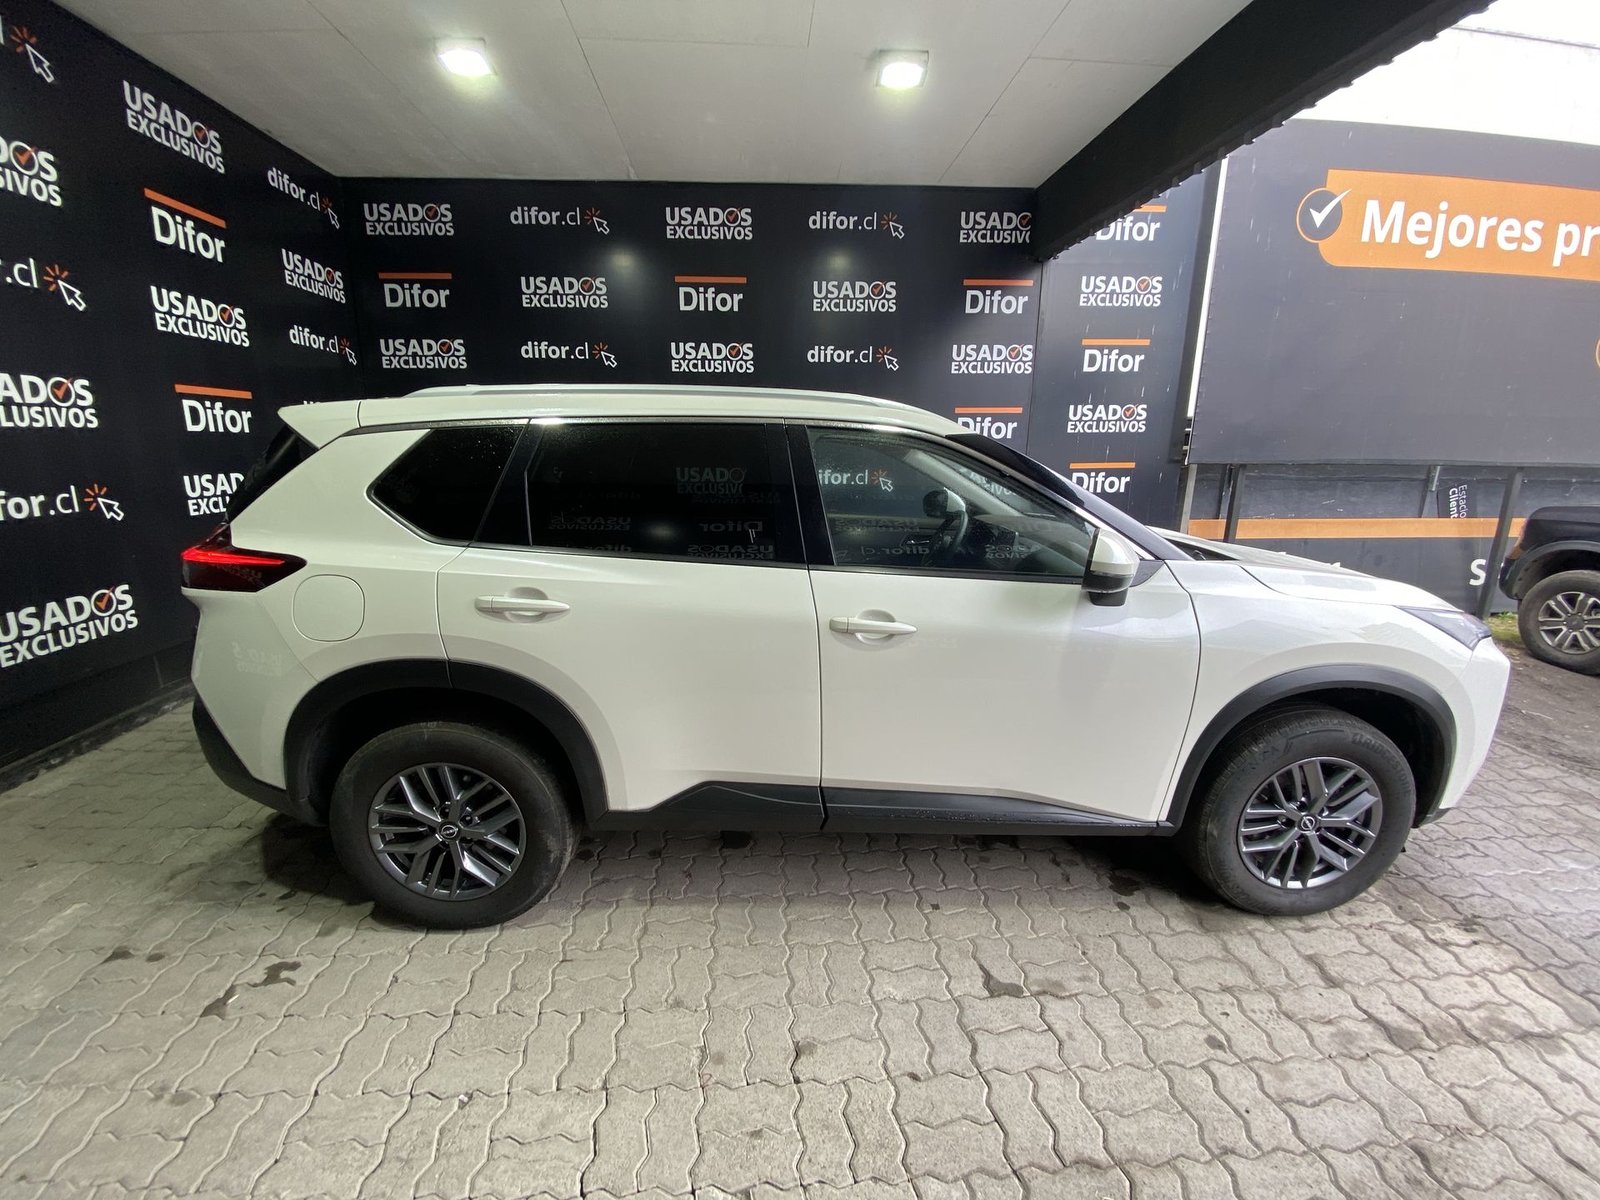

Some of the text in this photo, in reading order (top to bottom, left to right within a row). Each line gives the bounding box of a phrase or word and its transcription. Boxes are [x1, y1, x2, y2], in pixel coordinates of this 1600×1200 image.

[123, 80, 222, 155] USADOS
[127, 109, 225, 175] EXCLUSIVOS
[267, 167, 321, 211] difor.cl
[363, 203, 453, 223] USADOS
[510, 206, 580, 225] difor.cl
[665, 206, 752, 226] USADOS
[808, 211, 877, 230] difor.cl
[151, 206, 225, 263] Difor
[366, 221, 454, 236] EXCLUSIVOS
[666, 225, 753, 240] EXCLUSIVOS
[1361, 200, 1544, 259] Mejores
[281, 248, 344, 289] USADOS
[284, 270, 346, 304] EXCLUSIVOS
[520, 276, 607, 295] USADOS
[813, 281, 896, 299] USADOS
[1081, 276, 1163, 294] USADOS
[384, 283, 450, 309] Difor
[522, 294, 608, 308] EXCLUSIVOS
[679, 286, 743, 312] Difor
[812, 298, 896, 312] EXCLUSIVOS
[965, 289, 1028, 314] Difor
[1079, 293, 1161, 307] EXCLUSIVOS
[150, 285, 247, 330] USADOS
[155, 312, 250, 348] EXCLUSIVOS
[289, 325, 339, 354] difor.cl
[380, 339, 465, 357] USADOS
[521, 341, 589, 360] difor.cl
[671, 342, 754, 361] USADOS
[807, 346, 873, 363] difor.cl
[951, 344, 1033, 362] USADOS
[382, 356, 467, 369] EXCLUSIVOS
[671, 359, 754, 373] EXCLUSIVOS
[951, 361, 1033, 374] EXCLUSIVOS
[1082, 348, 1145, 373] Difor
[182, 399, 252, 433] Difor
[1068, 404, 1147, 421] USADOS
[1067, 420, 1146, 433] EXCLUSIVOS
[1072, 471, 1131, 493] Difor
[0, 584, 134, 643] USADOS
[0, 609, 139, 668] EXCLUSIVOS
